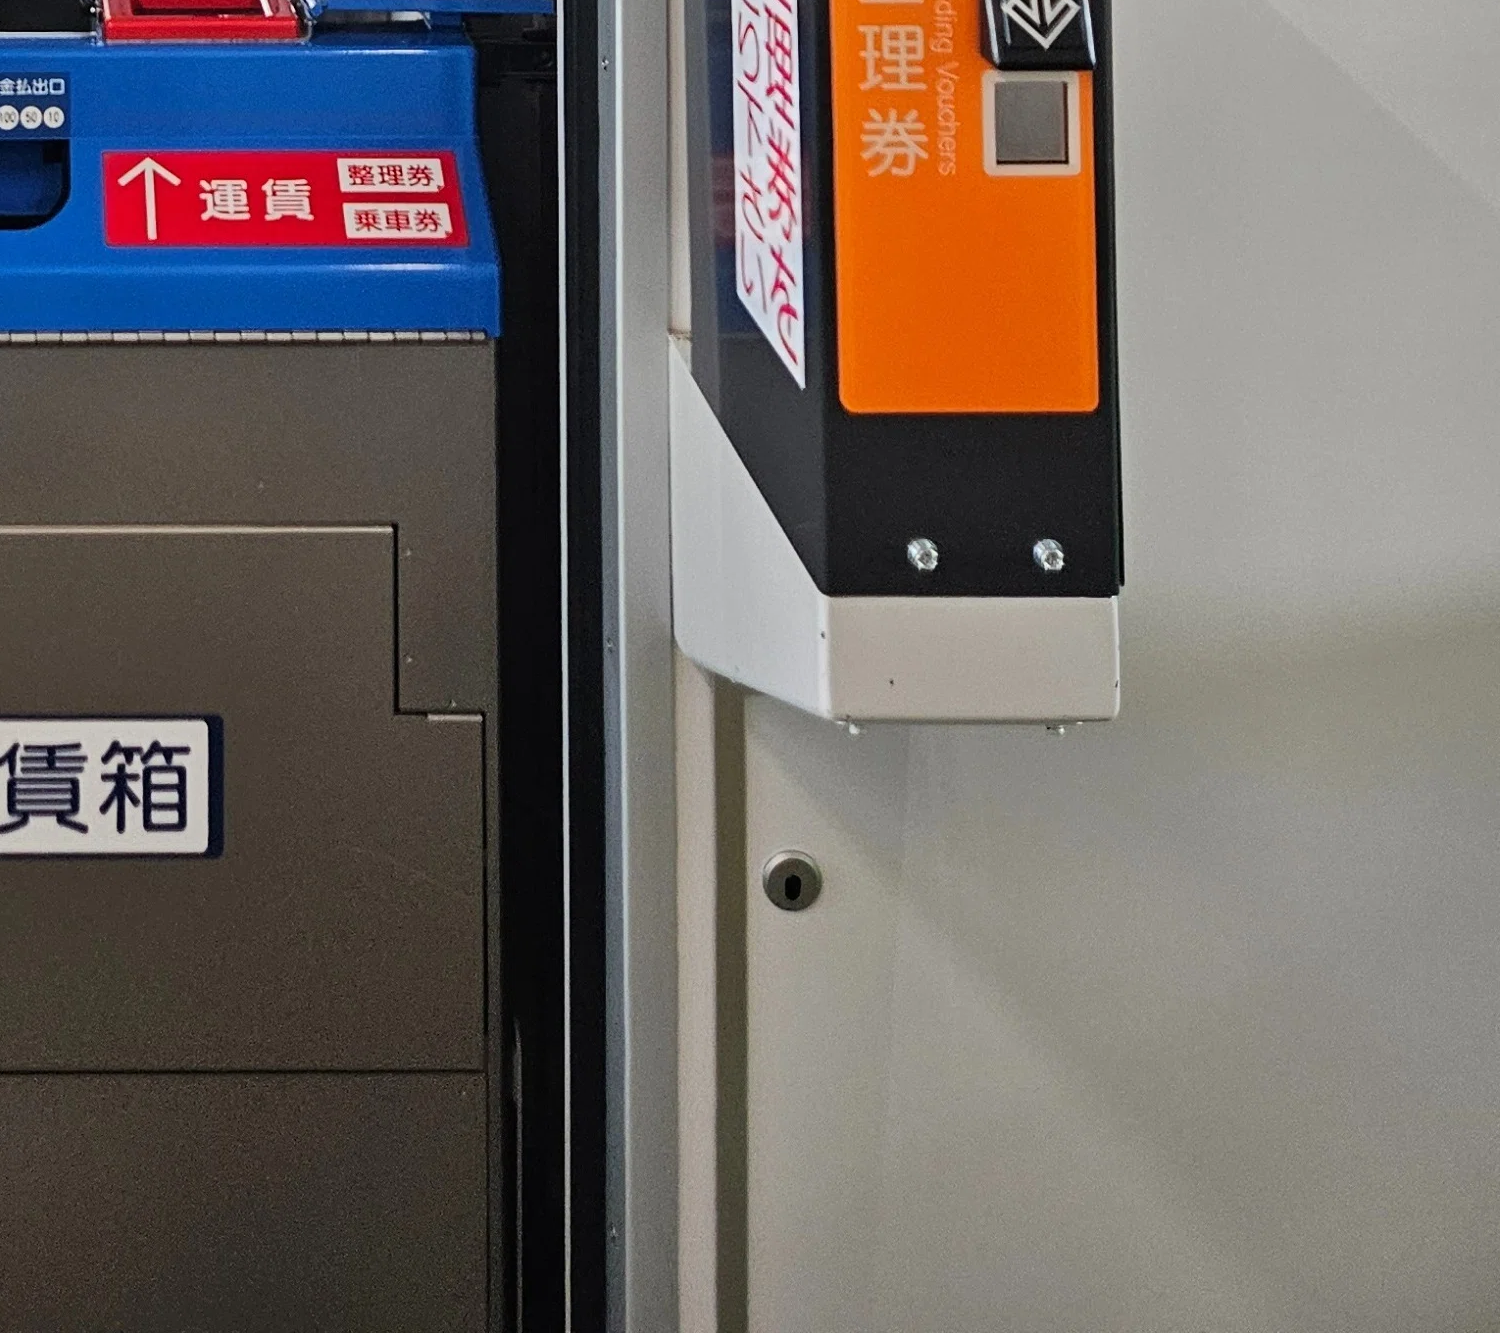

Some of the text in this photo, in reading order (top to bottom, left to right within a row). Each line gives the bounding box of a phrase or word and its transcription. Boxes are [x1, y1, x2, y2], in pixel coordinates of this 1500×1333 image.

[932, 60, 959, 177] Vouchers
[346, 163, 435, 187] 整理券
[198, 177, 315, 222] 運賃
[353, 209, 442, 234] 乗車券
